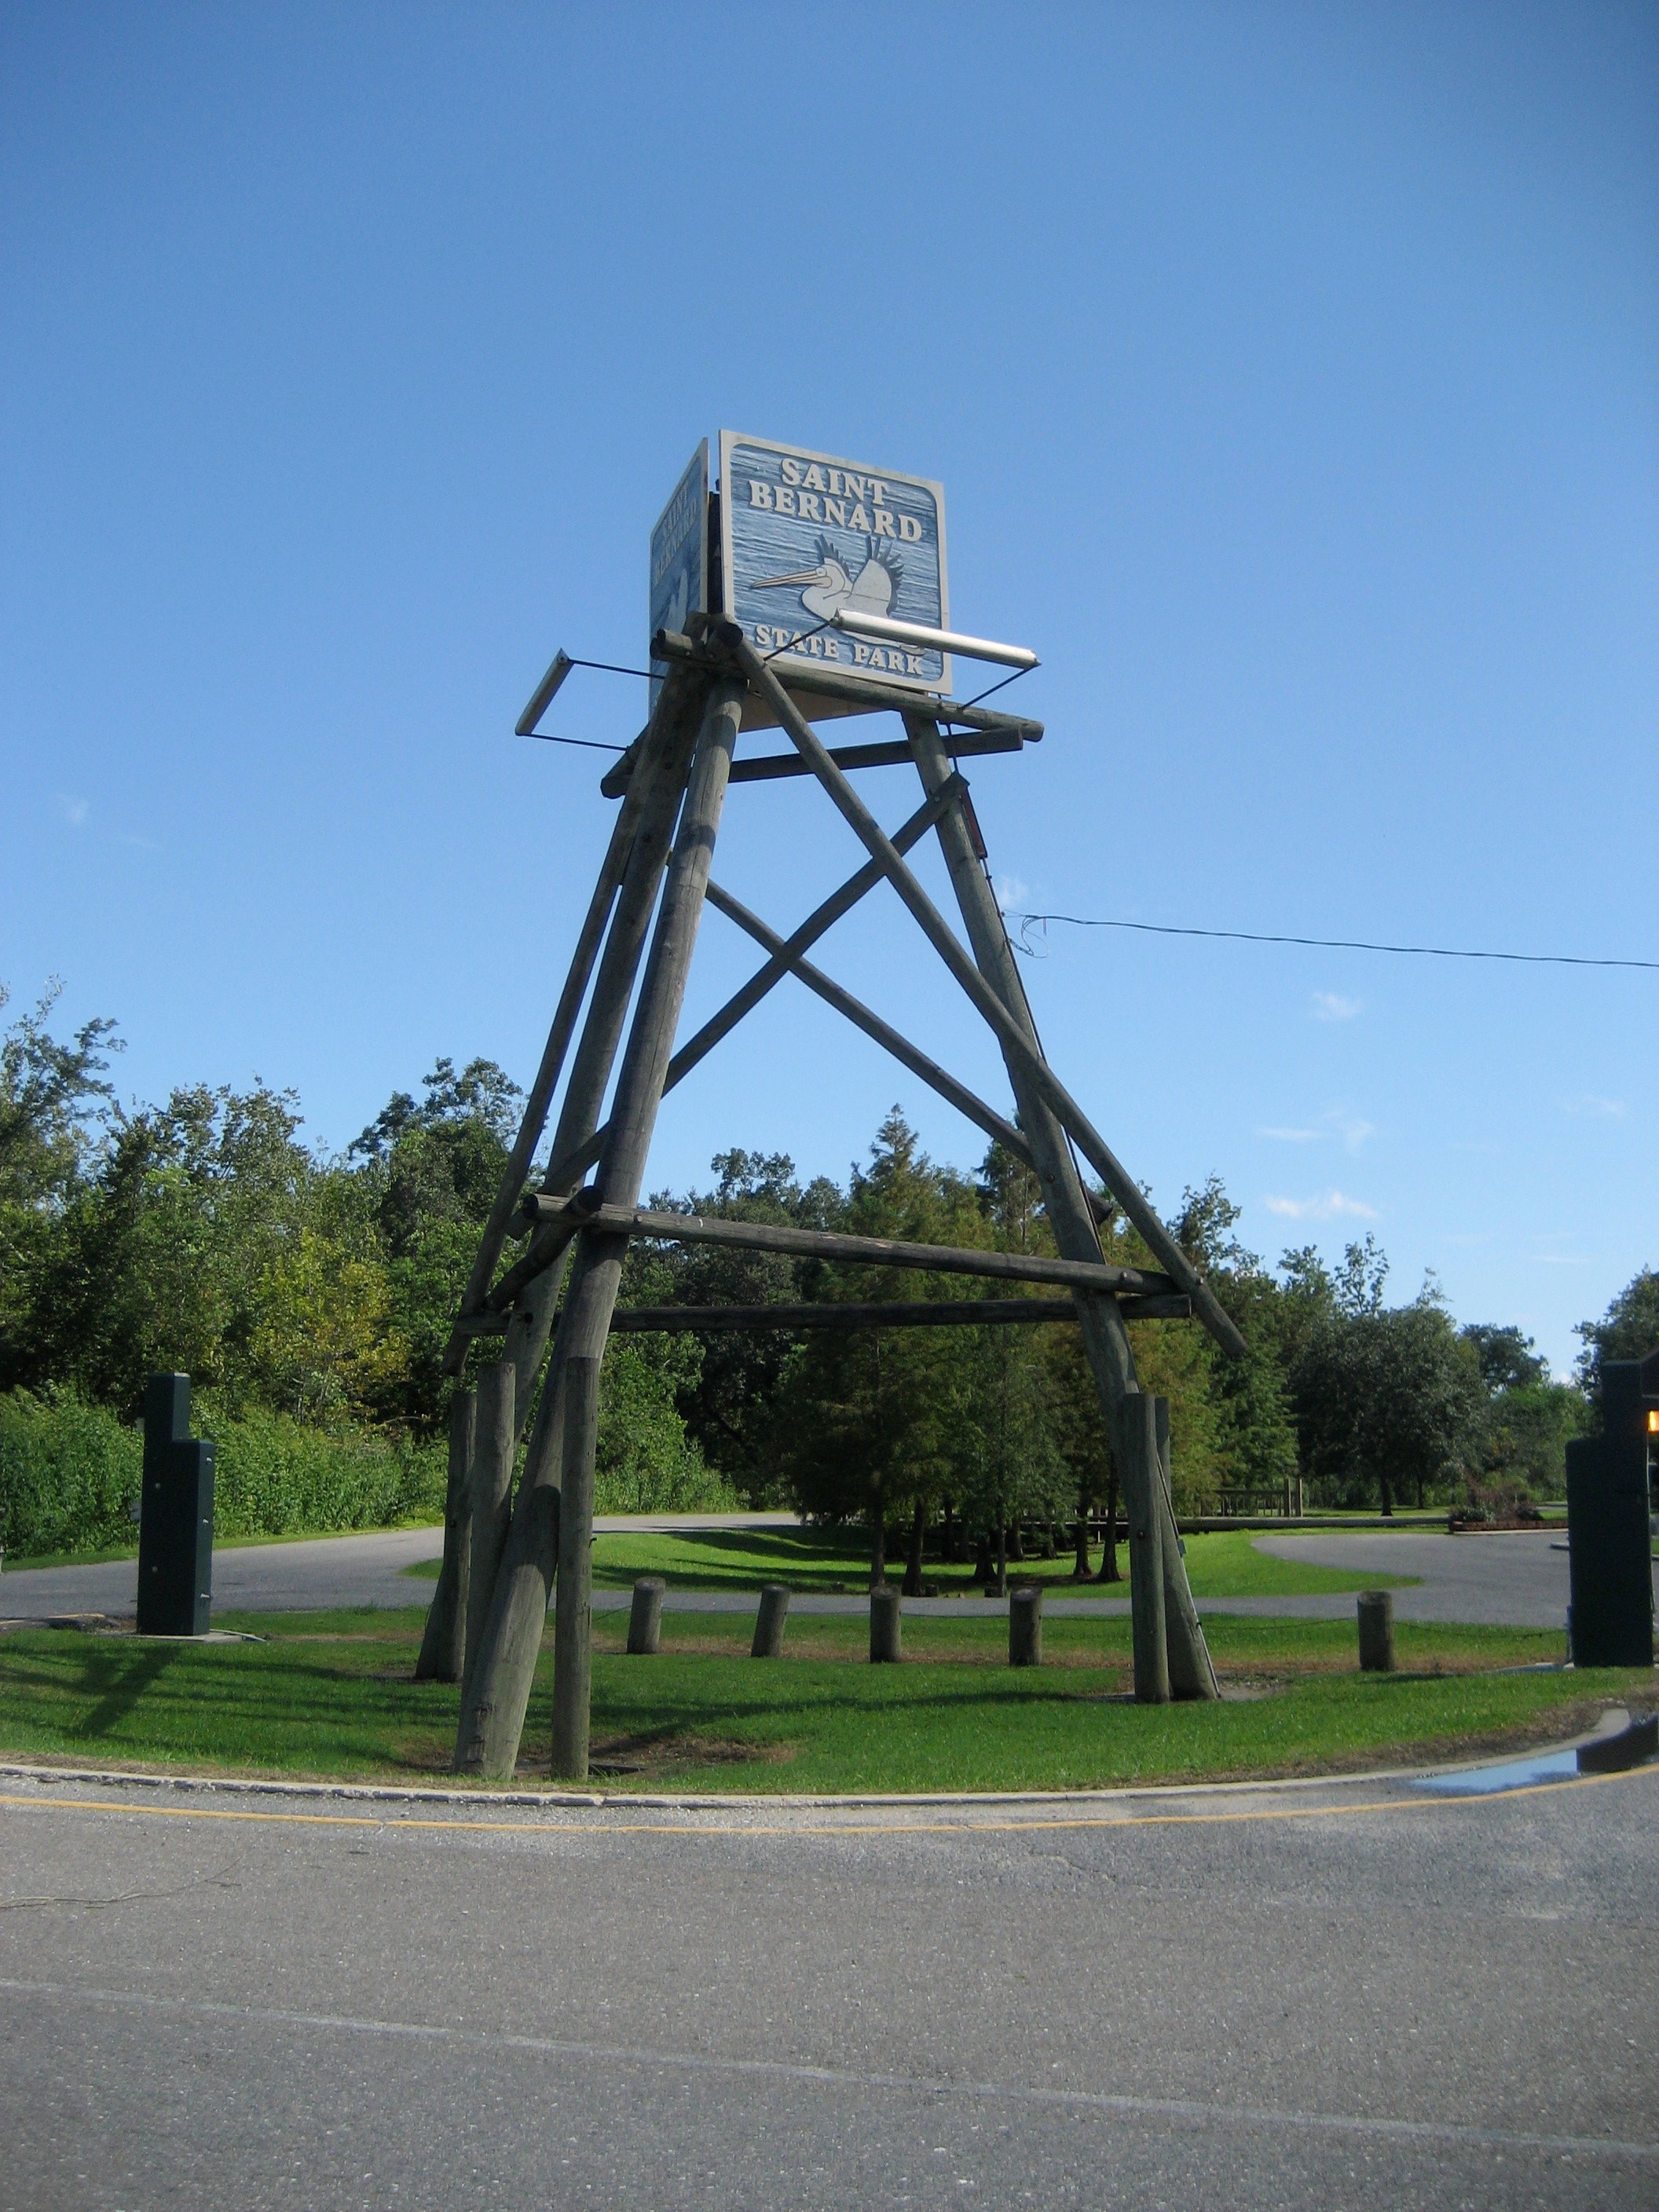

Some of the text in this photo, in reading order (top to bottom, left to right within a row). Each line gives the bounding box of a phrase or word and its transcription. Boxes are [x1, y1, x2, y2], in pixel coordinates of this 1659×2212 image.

[782, 458, 888, 506] SAINT
[748, 480, 922, 542] BERNARD
[756, 624, 923, 675] STATE PARK
